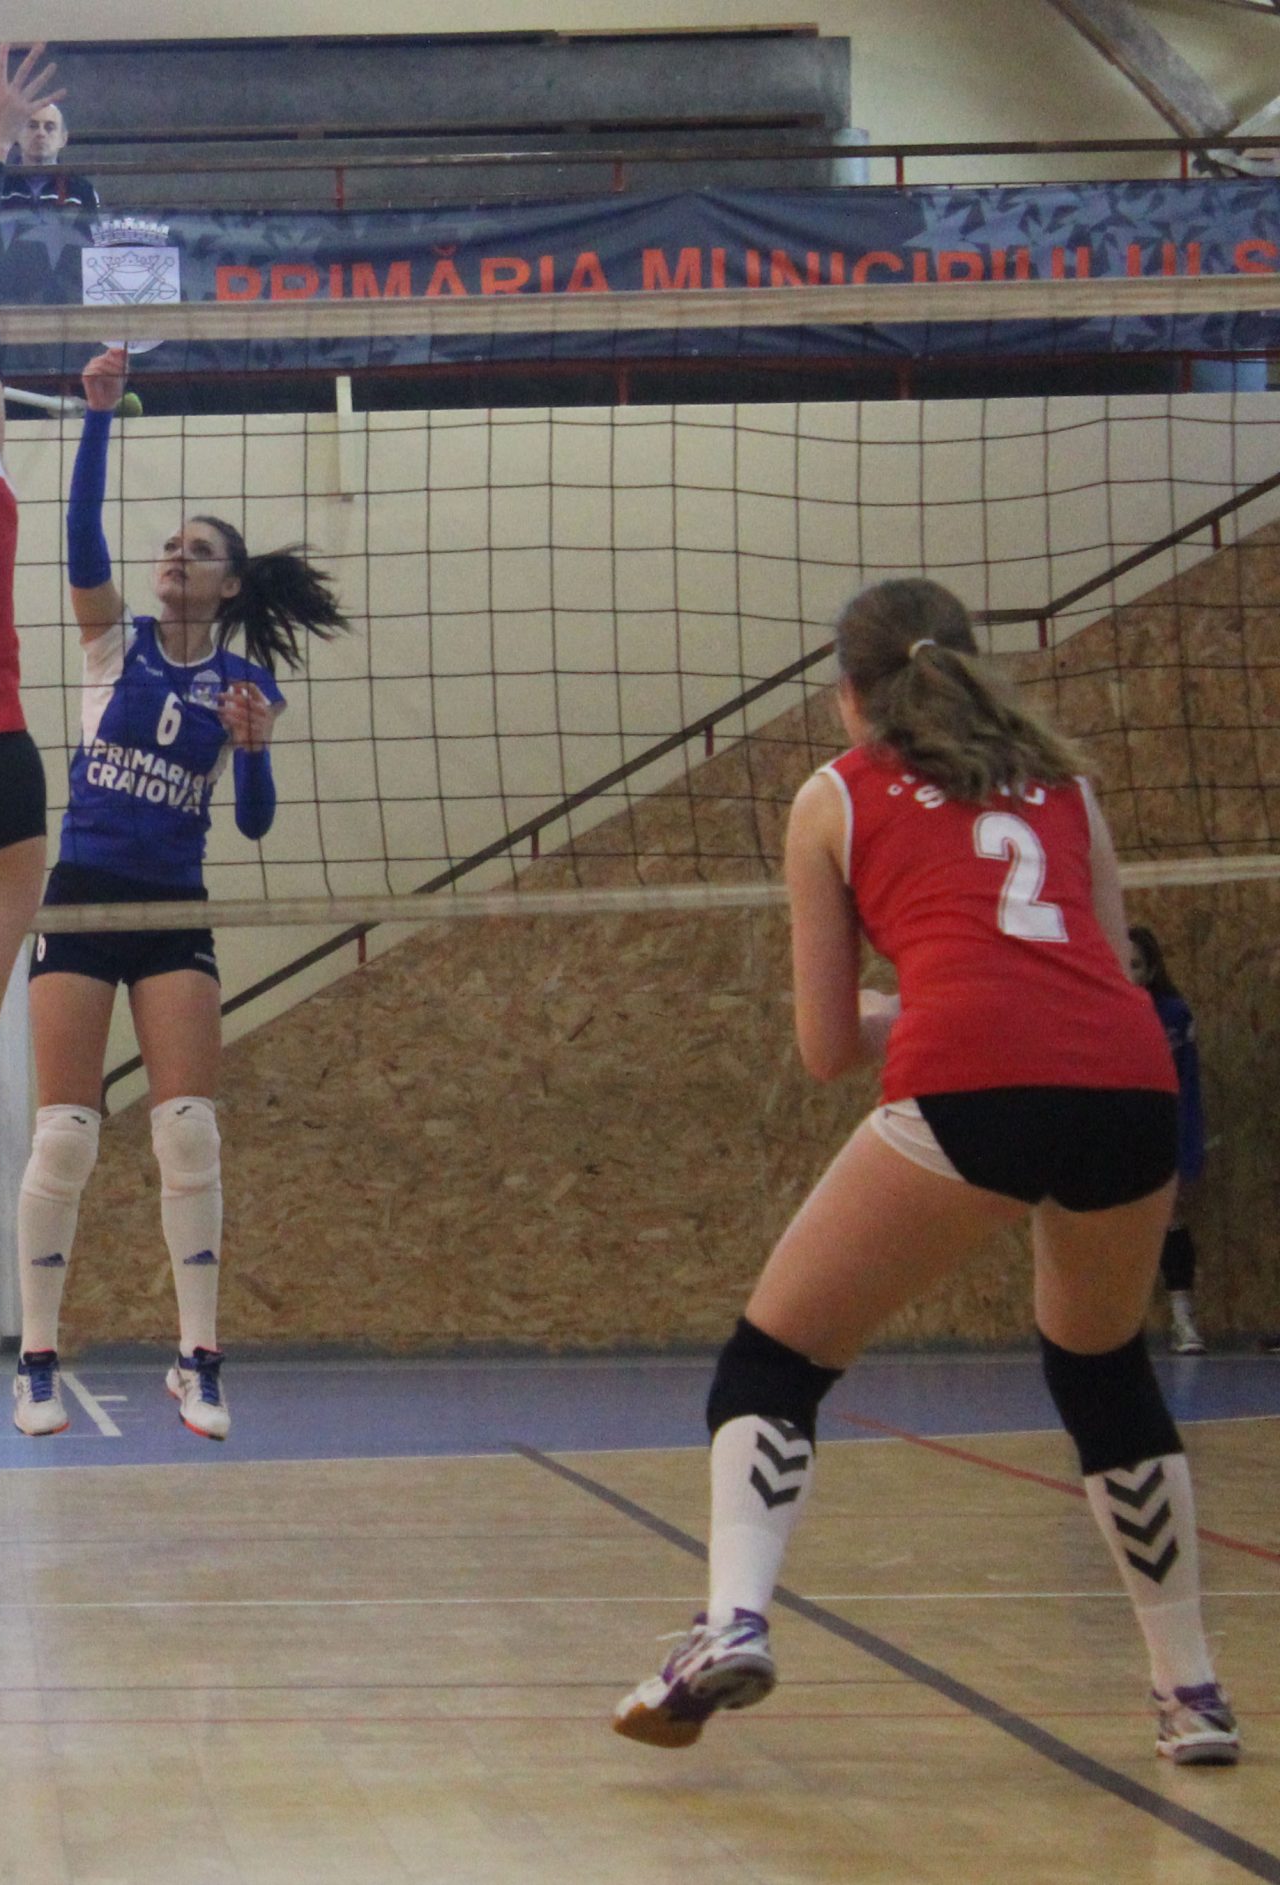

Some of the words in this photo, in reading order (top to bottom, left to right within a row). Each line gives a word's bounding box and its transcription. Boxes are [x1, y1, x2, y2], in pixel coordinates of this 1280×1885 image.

[156, 692, 184, 746] 6
[86, 761, 203, 816] CRAIOVA
[972, 811, 1070, 943] 2
